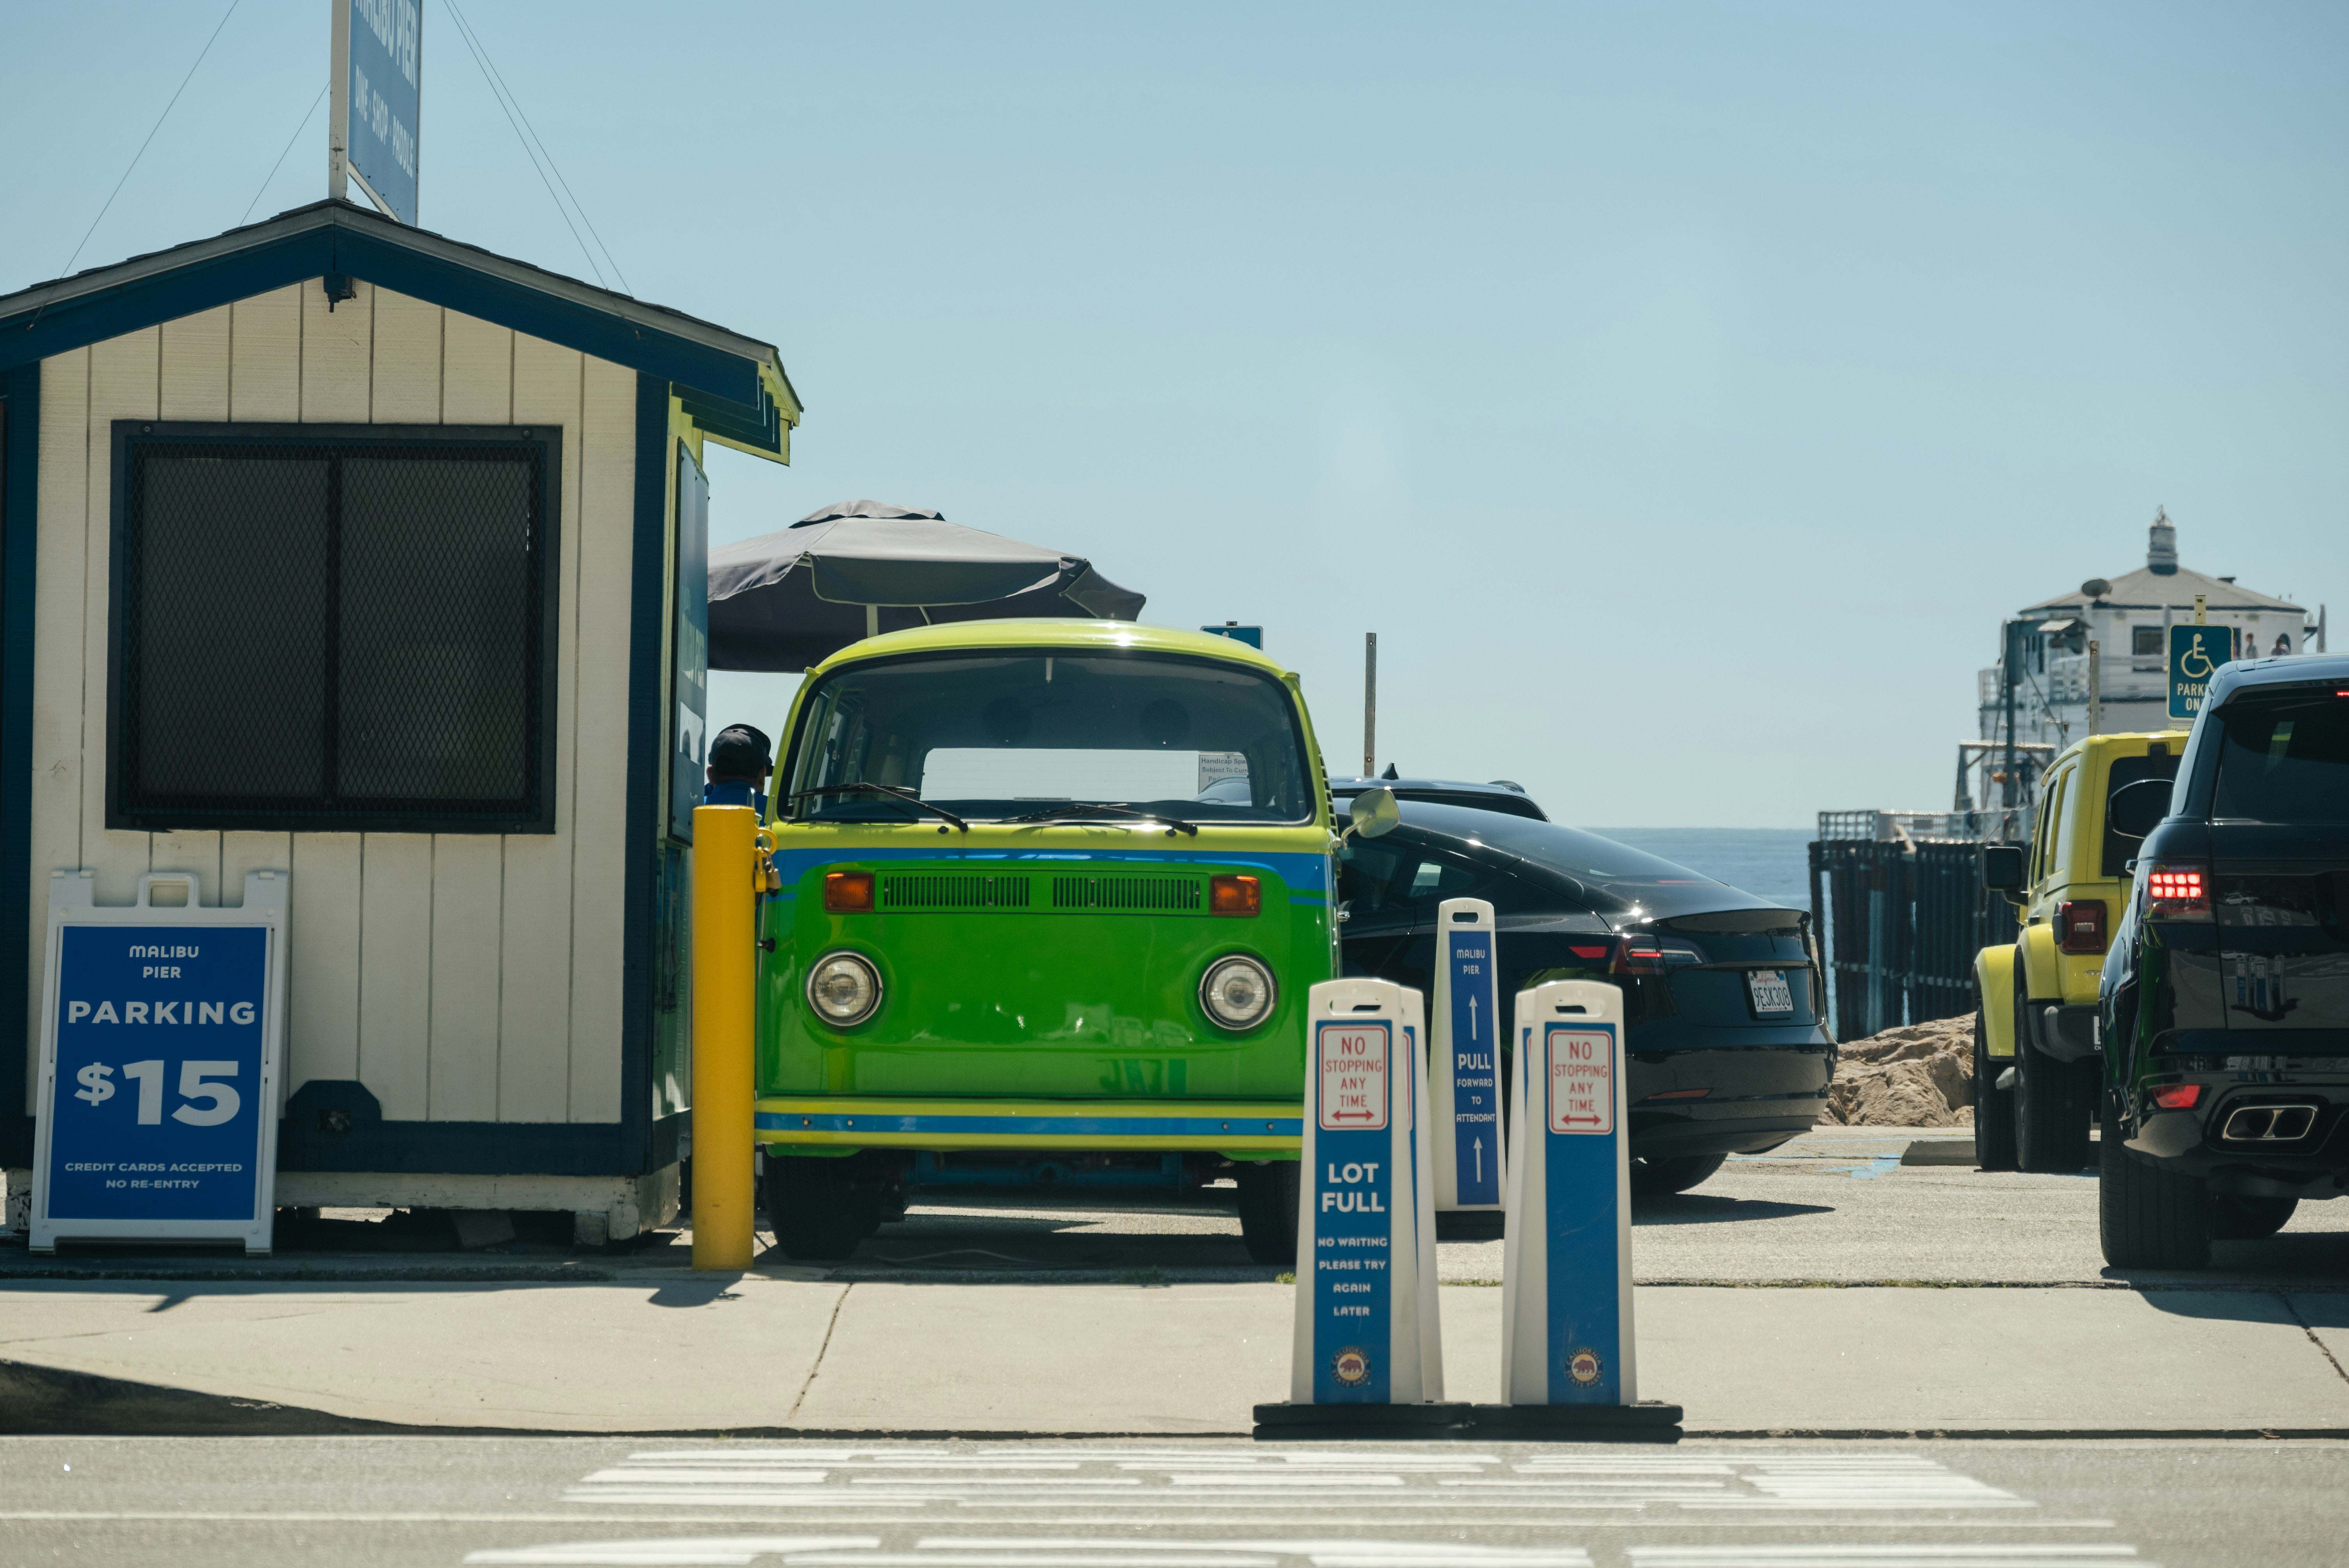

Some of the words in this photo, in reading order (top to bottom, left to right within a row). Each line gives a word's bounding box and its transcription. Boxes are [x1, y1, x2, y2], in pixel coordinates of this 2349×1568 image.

[396, 0, 416, 90] PIER
[355, 64, 368, 122] DINE
[372, 89, 388, 145] SHOP
[392, 115, 413, 178] PADDLE
[2186, 698, 2203, 711] ON
[129, 946, 199, 958] MALIBU
[1456, 949, 1485, 959] MALIBU
[143, 966, 181, 978] PIER
[1463, 965, 1479, 975] PIER
[1754, 987, 1790, 1007] 9ESK308
[68, 1001, 255, 1025] PARKING
[1341, 1037, 1365, 1055] NO
[1569, 1041, 1592, 1060] NO
[1326, 1059, 1383, 1073] STOPPING
[1458, 1053, 1491, 1070] PULL
[1554, 1065, 1608, 1079] STOPPING
[1340, 1078, 1365, 1089] ANY
[1457, 1078, 1493, 1087] FORWARD
[1570, 1083, 1593, 1094] ANY
[74, 1060, 240, 1126] $15
[1340, 1095, 1366, 1107] TIME
[1471, 1096, 1481, 1105] TO
[1569, 1099, 1592, 1112] TIME
[1456, 1113, 1495, 1123] ATTENDANT
[65, 1163, 115, 1171] CREDIT
[118, 1163, 166, 1171] CARDS
[169, 1164, 242, 1172] ACCEPTED
[1329, 1163, 1379, 1183] LOT
[106, 1180, 127, 1188] NO
[131, 1180, 200, 1188] RE-ENTRY
[1322, 1192, 1385, 1212] FULL
[1318, 1237, 1335, 1247] NO
[1337, 1237, 1387, 1247] WAITING
[1319, 1260, 1360, 1270] PLEASE
[1364, 1260, 1386, 1270] TRY
[1333, 1283, 1371, 1293] AGAIN
[1333, 1306, 1370, 1316] LATER
[1566, 1347, 1602, 1366] CALIFORNIA
